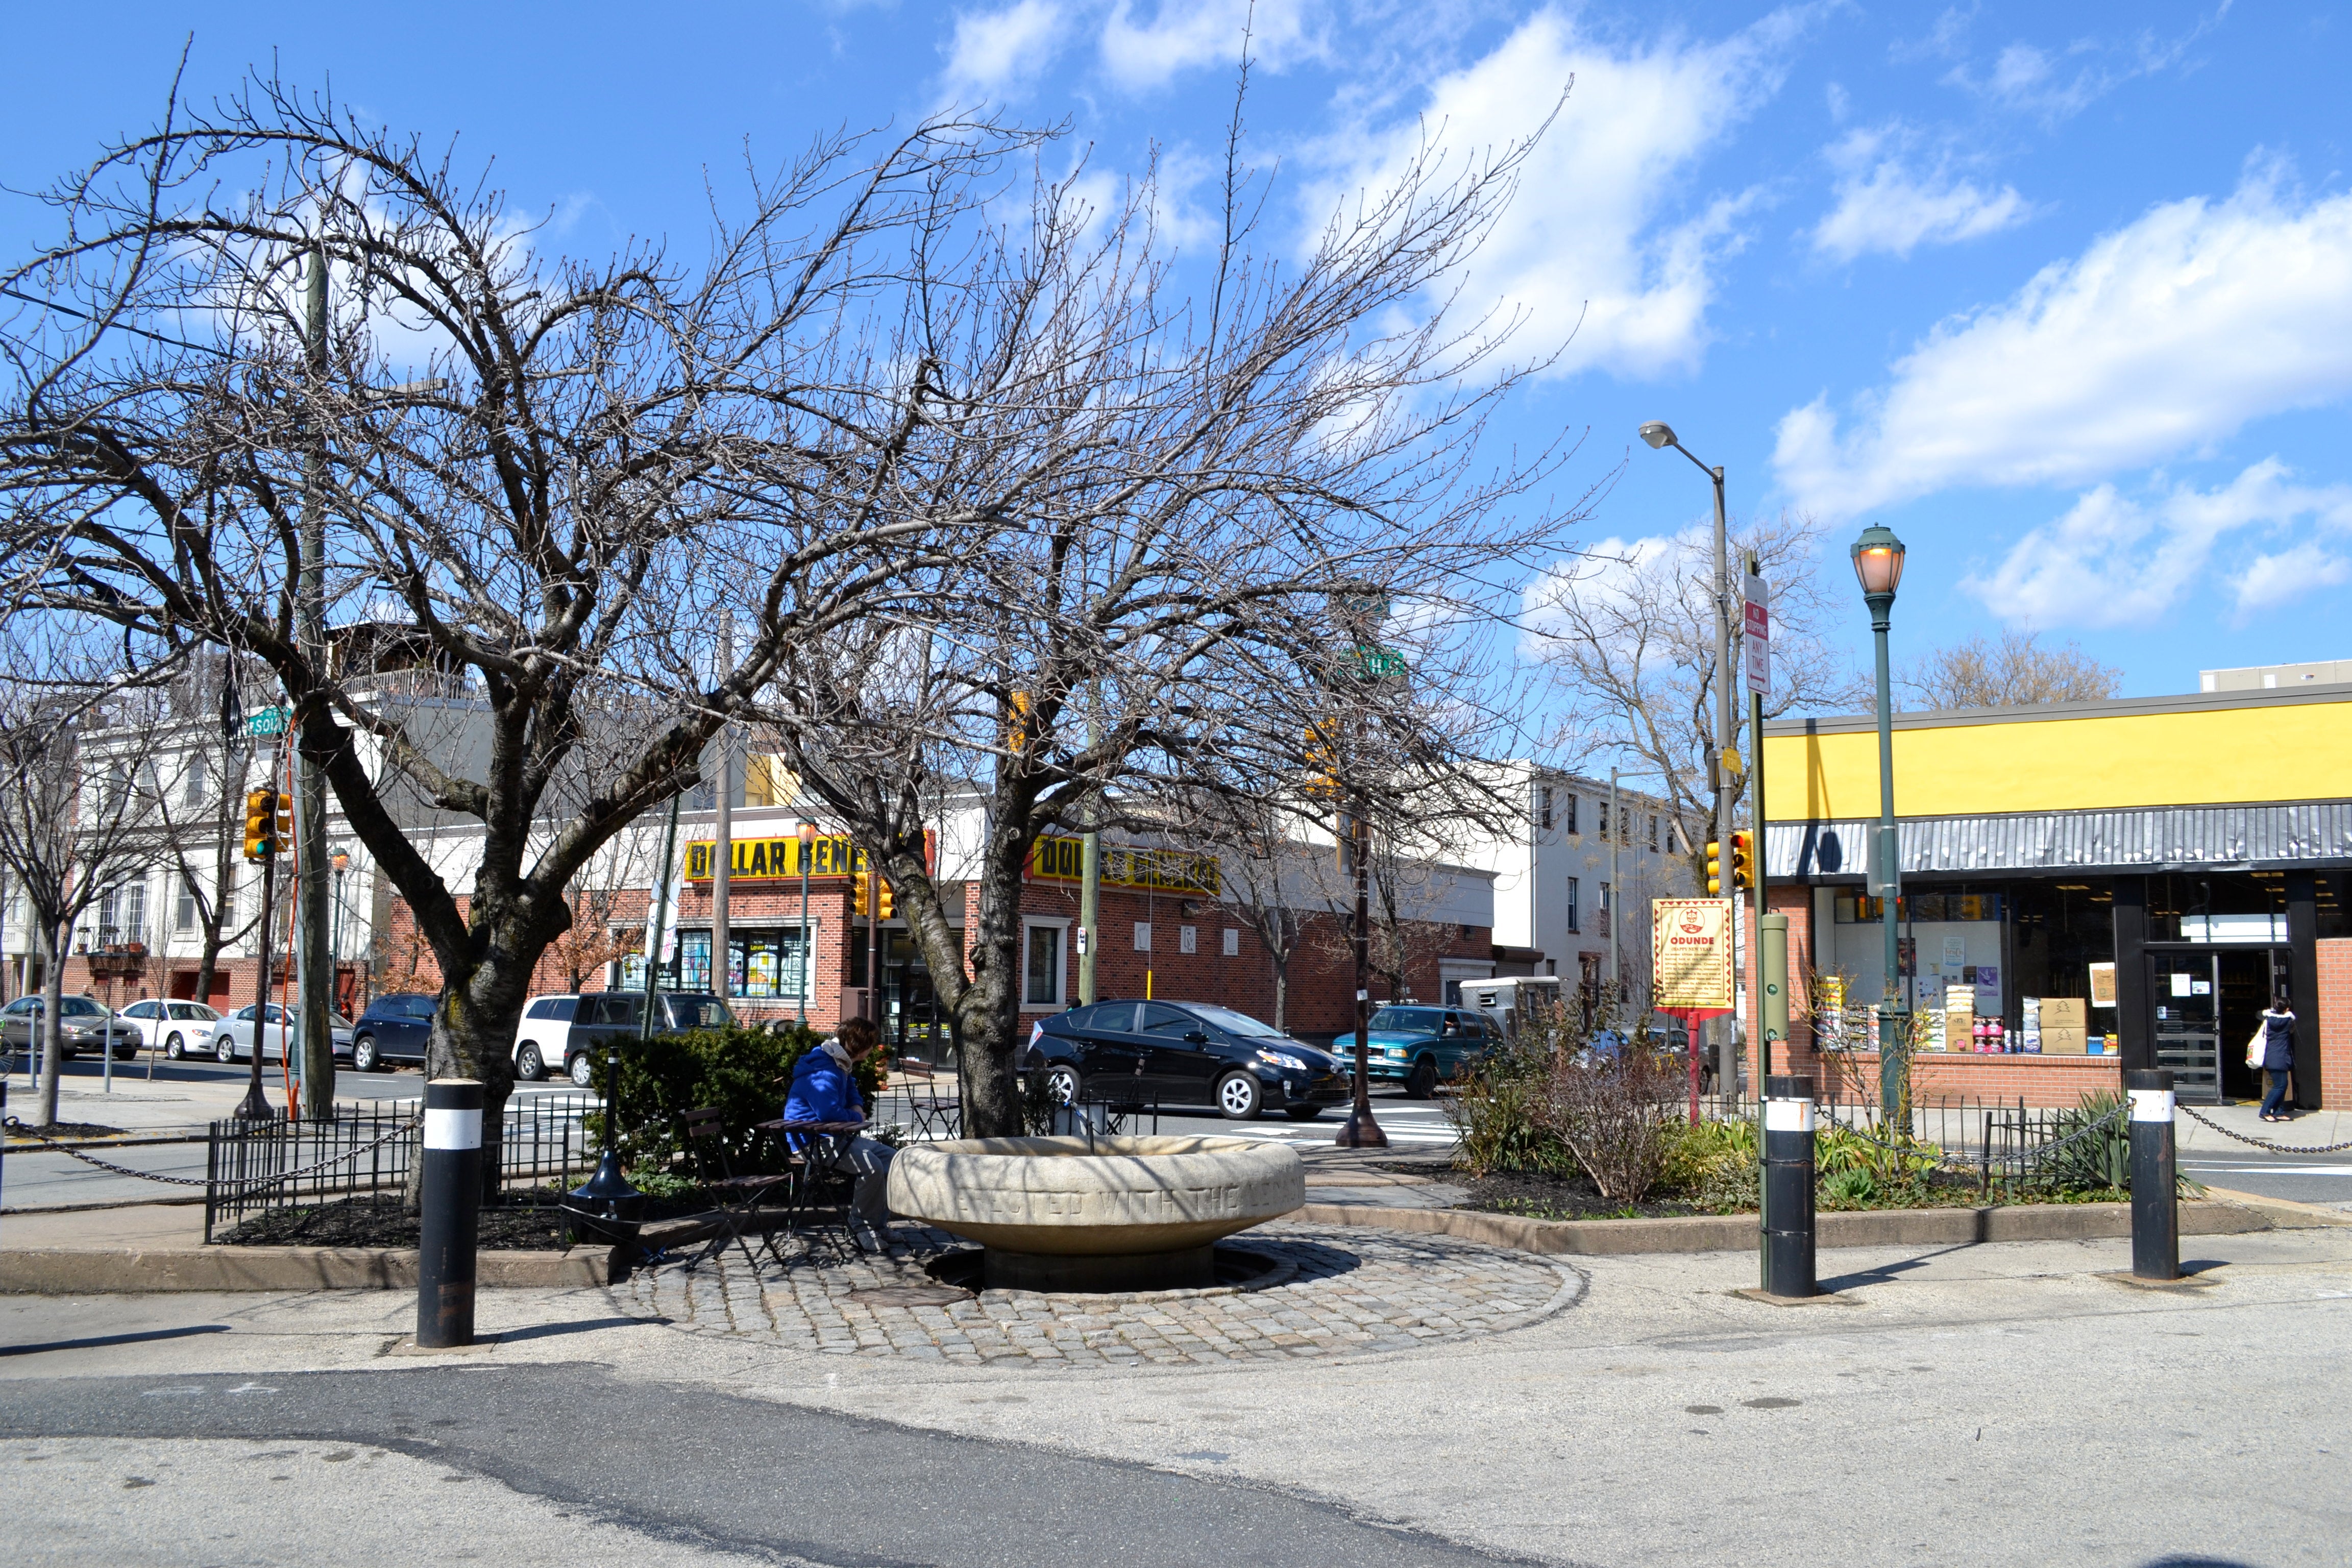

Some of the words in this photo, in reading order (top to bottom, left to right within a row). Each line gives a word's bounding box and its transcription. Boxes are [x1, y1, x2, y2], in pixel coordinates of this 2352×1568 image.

[1753, 607, 1759, 620] NO
[1746, 619, 1767, 636] STOPPING
[1752, 640, 1763, 655] ANY
[1752, 655, 1764, 672] TIME
[1042, 840, 1126, 881] DOLAR
[3, 932, 15, 943] 2311
[958, 1189, 1082, 1215] ERECTED
[1100, 1190, 1173, 1215] WITH
[1188, 1186, 1238, 1212] THE
